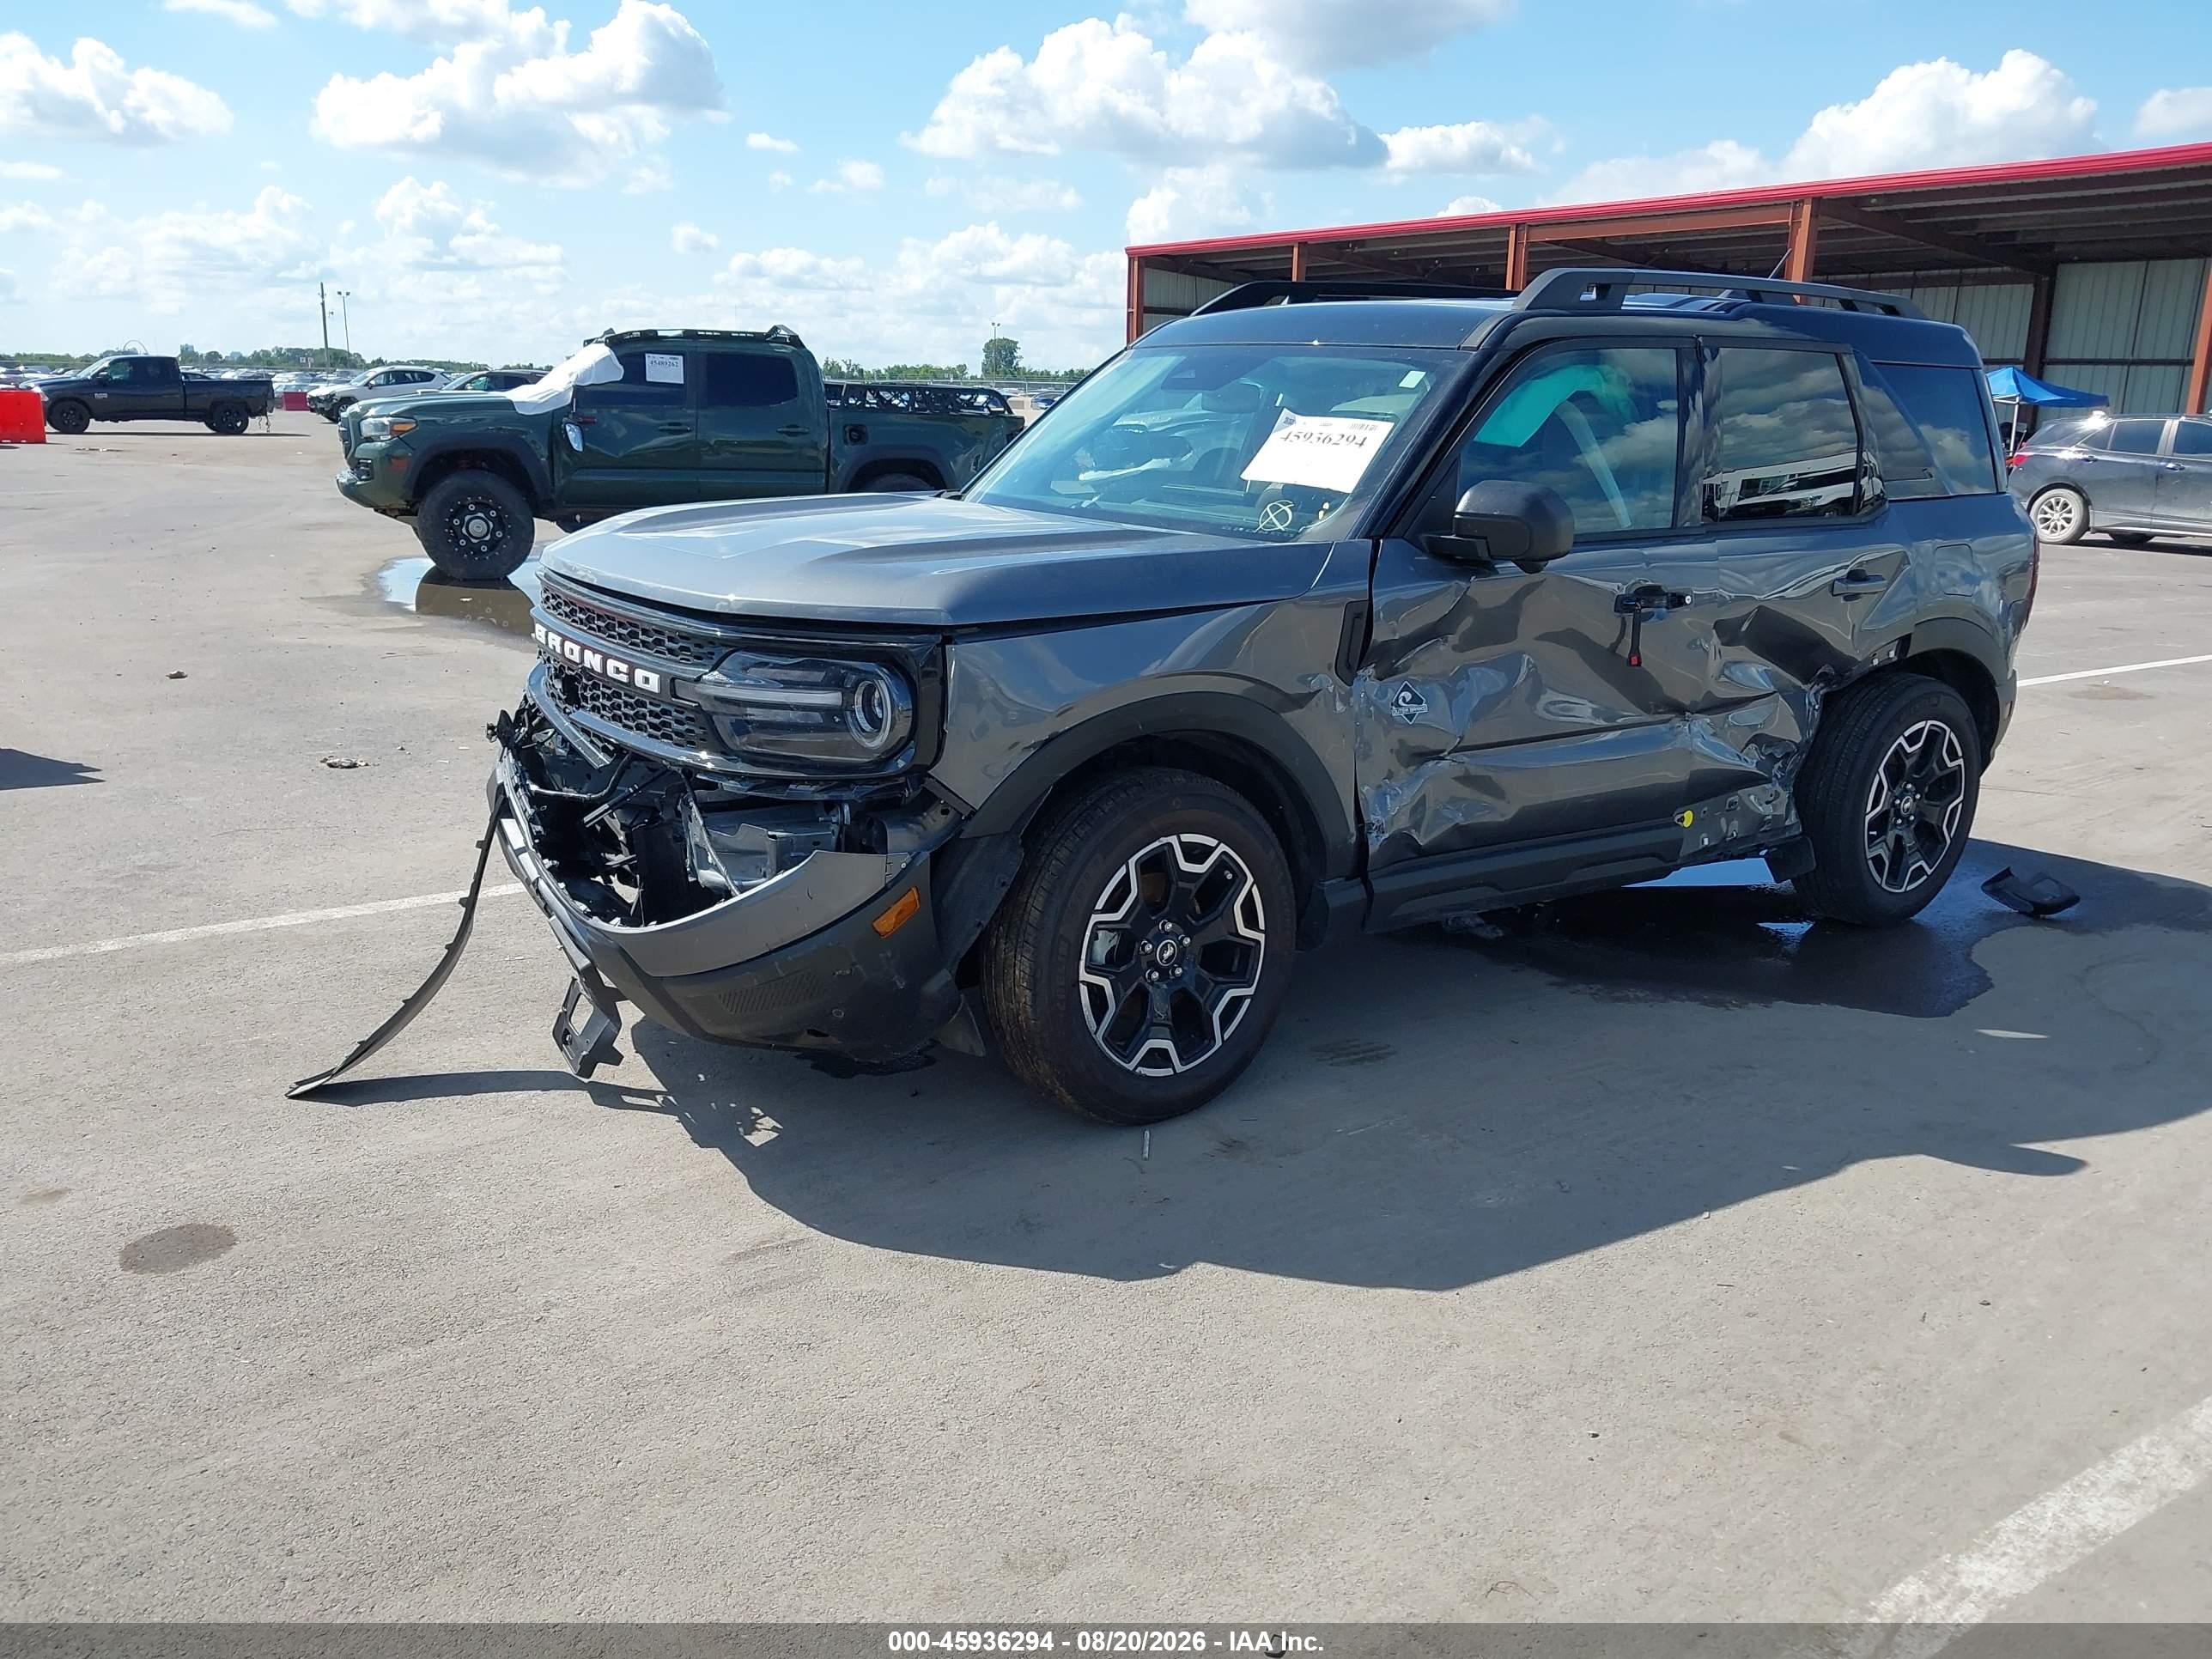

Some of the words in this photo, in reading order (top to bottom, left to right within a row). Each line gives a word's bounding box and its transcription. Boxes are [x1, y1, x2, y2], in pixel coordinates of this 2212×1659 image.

[1279, 430, 1368, 447] 45936294
[535, 623, 660, 694] BRONCO
[1409, 705, 1426, 714] BANKS
